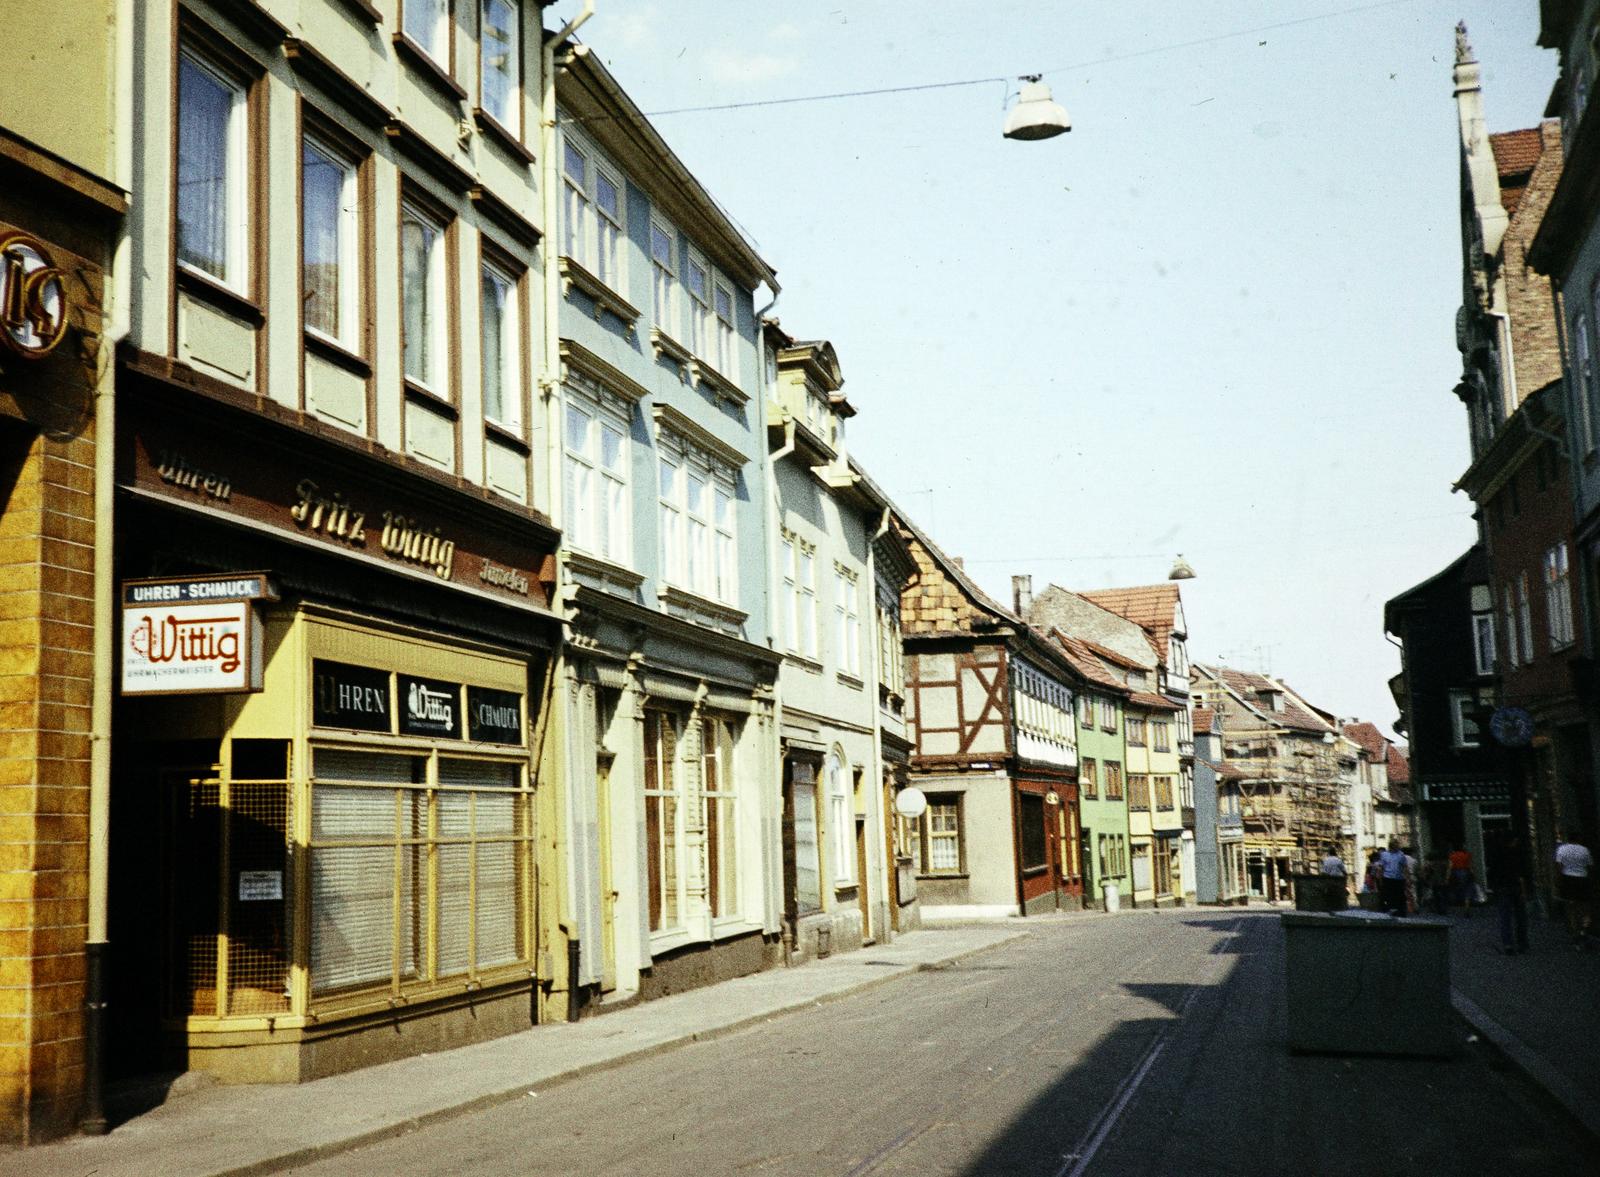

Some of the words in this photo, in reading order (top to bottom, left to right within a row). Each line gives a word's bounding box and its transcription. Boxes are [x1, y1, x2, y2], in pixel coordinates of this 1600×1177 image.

[157, 449, 231, 498] Uhren
[290, 478, 366, 542] Fritz
[381, 510, 455, 580] Wittig
[142, 615, 240, 673] Wittig
[318, 674, 385, 714] UHREN
[409, 682, 454, 731] Wittig
[470, 697, 520, 730] SCHMUCK
